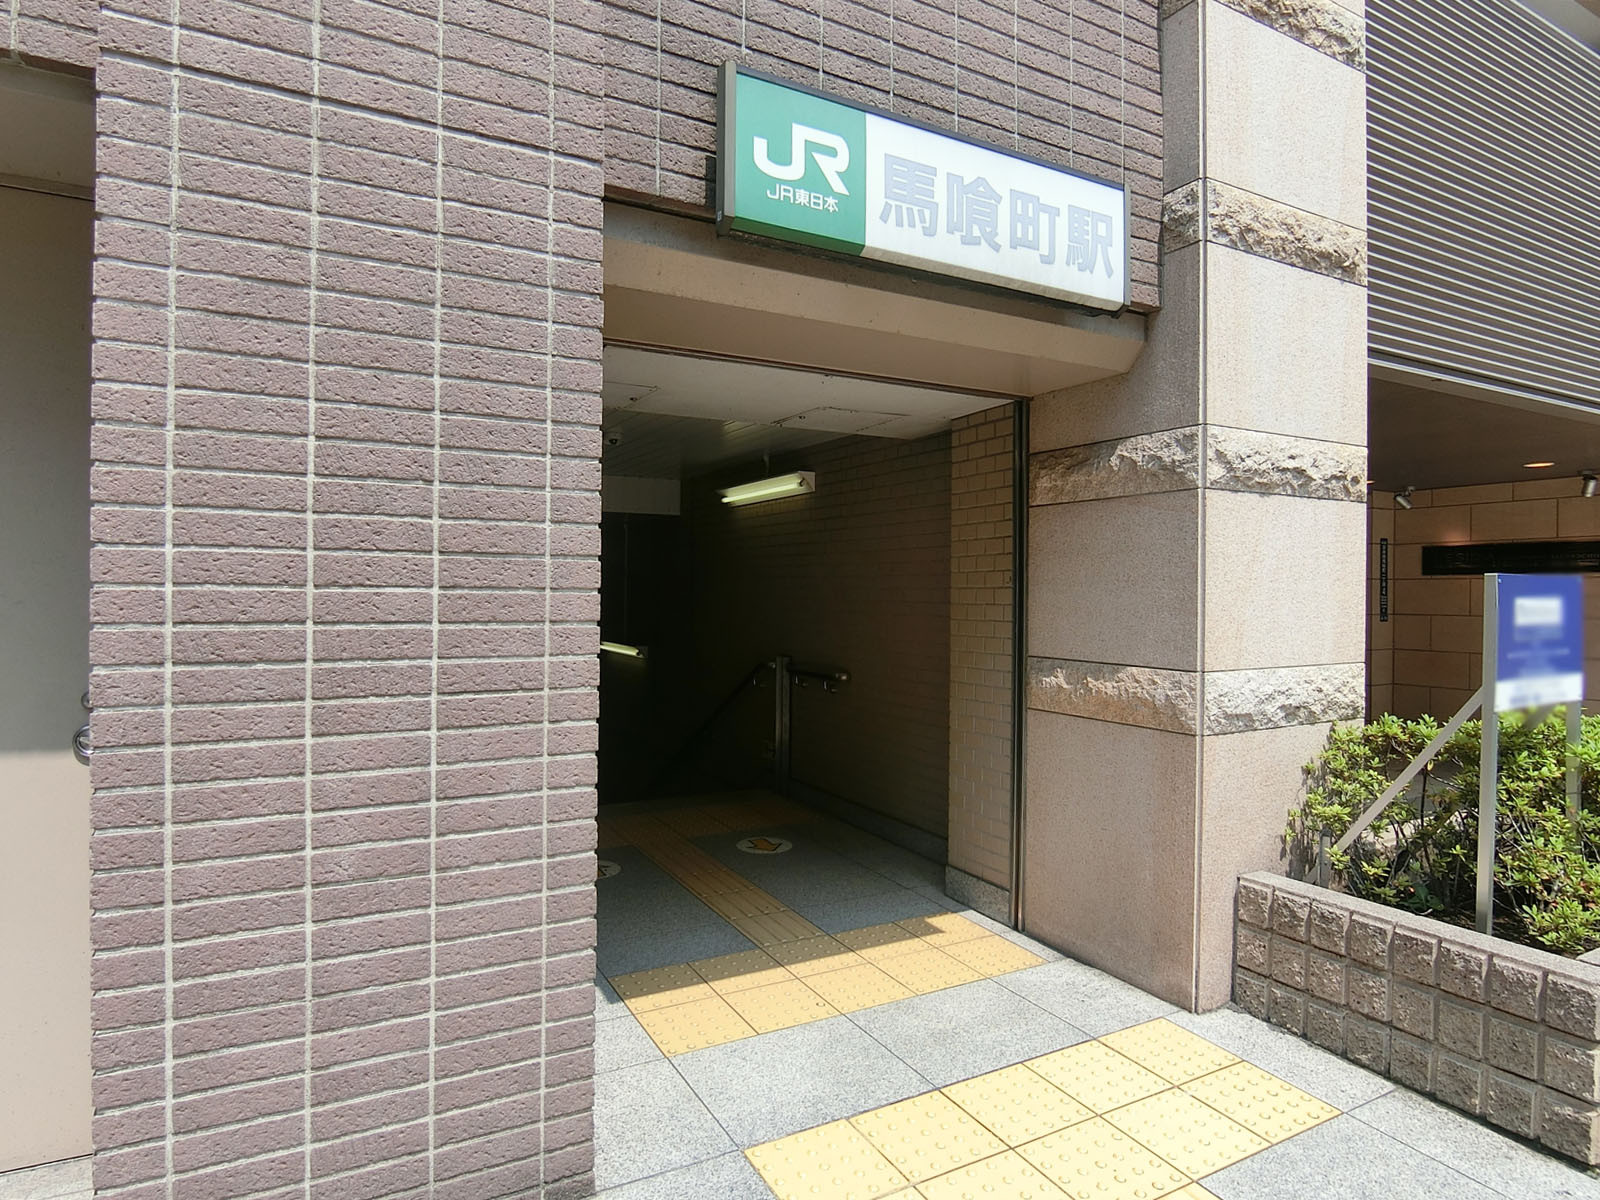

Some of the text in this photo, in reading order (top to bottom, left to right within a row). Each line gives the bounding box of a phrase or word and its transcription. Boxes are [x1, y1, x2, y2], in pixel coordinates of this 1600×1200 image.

[753, 122, 850, 196] JR
[766, 183, 839, 213] JR東日本
[879, 153, 1114, 279] 馬喰町駅
